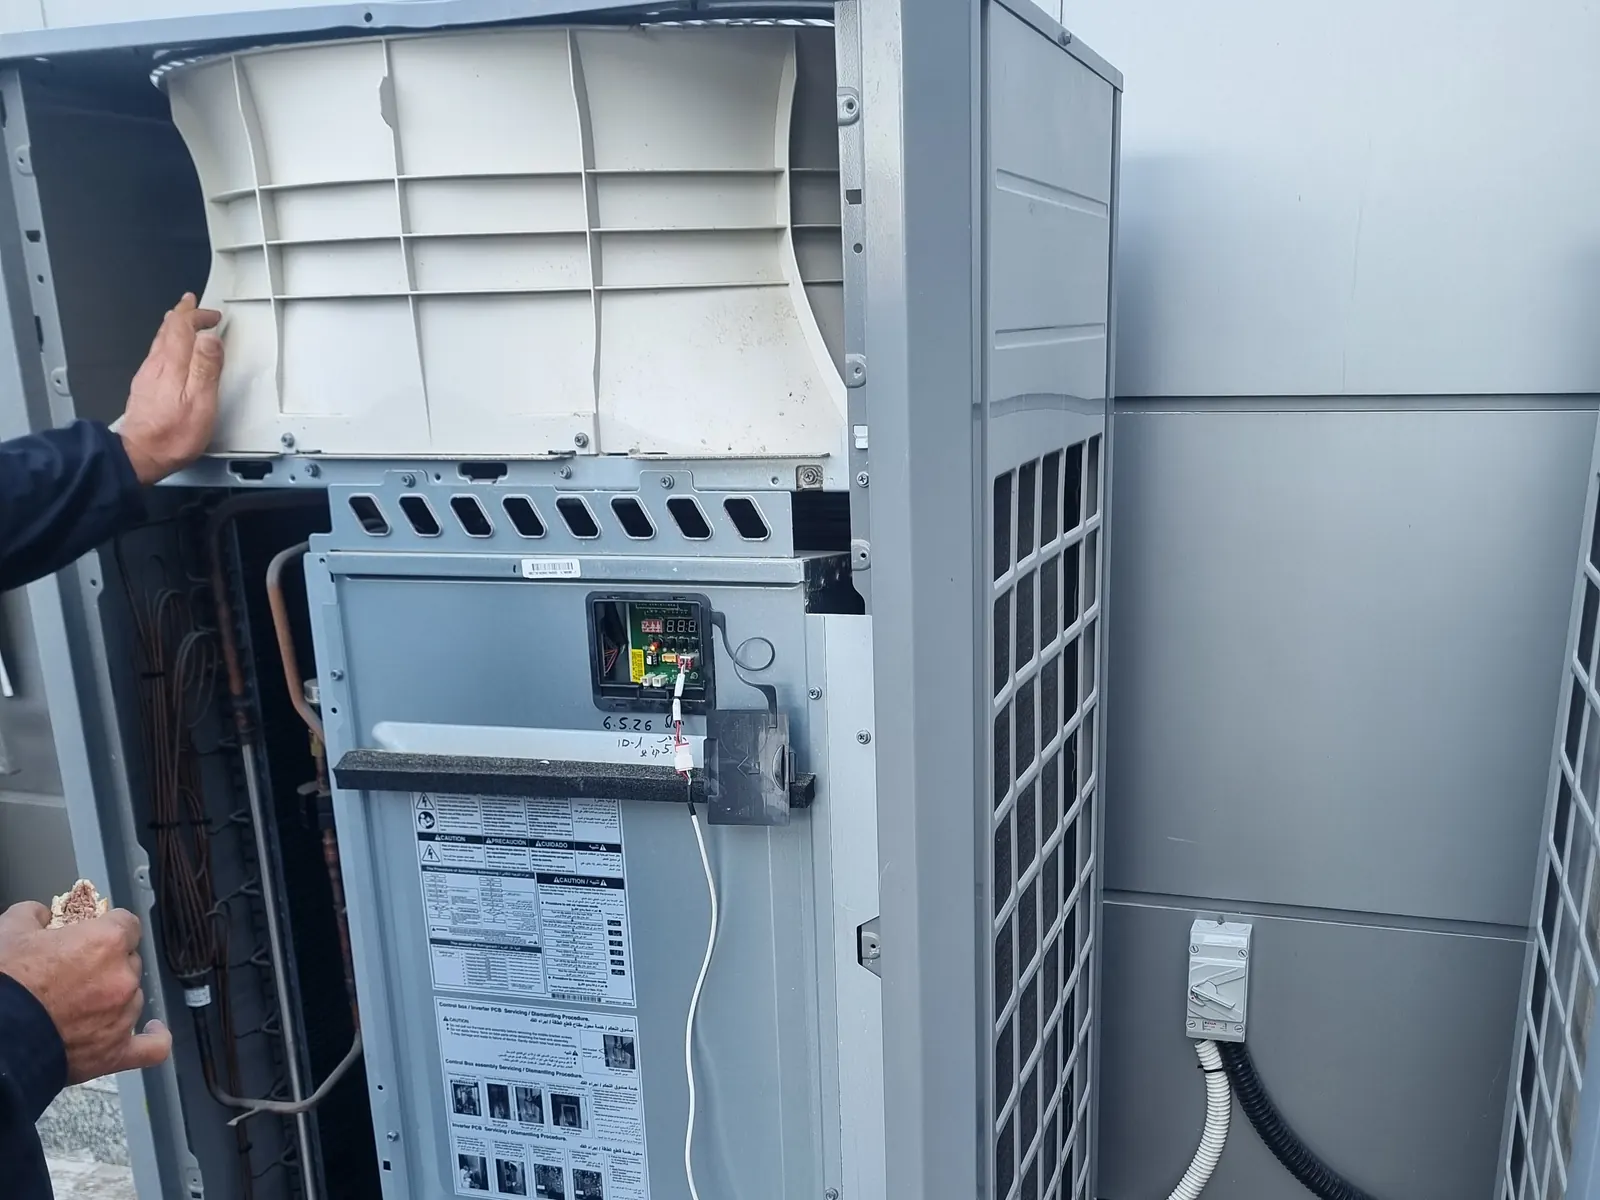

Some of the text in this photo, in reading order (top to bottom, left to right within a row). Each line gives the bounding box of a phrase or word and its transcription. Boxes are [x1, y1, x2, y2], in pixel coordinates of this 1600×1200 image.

[603, 716, 652, 731] 6.5.26
[491, 838, 527, 846] PRECAUCIÓN
[504, 1008, 528, 1016] Servicing
[475, 1062, 498, 1070] assembly
[484, 1126, 507, 1135] Servicing
